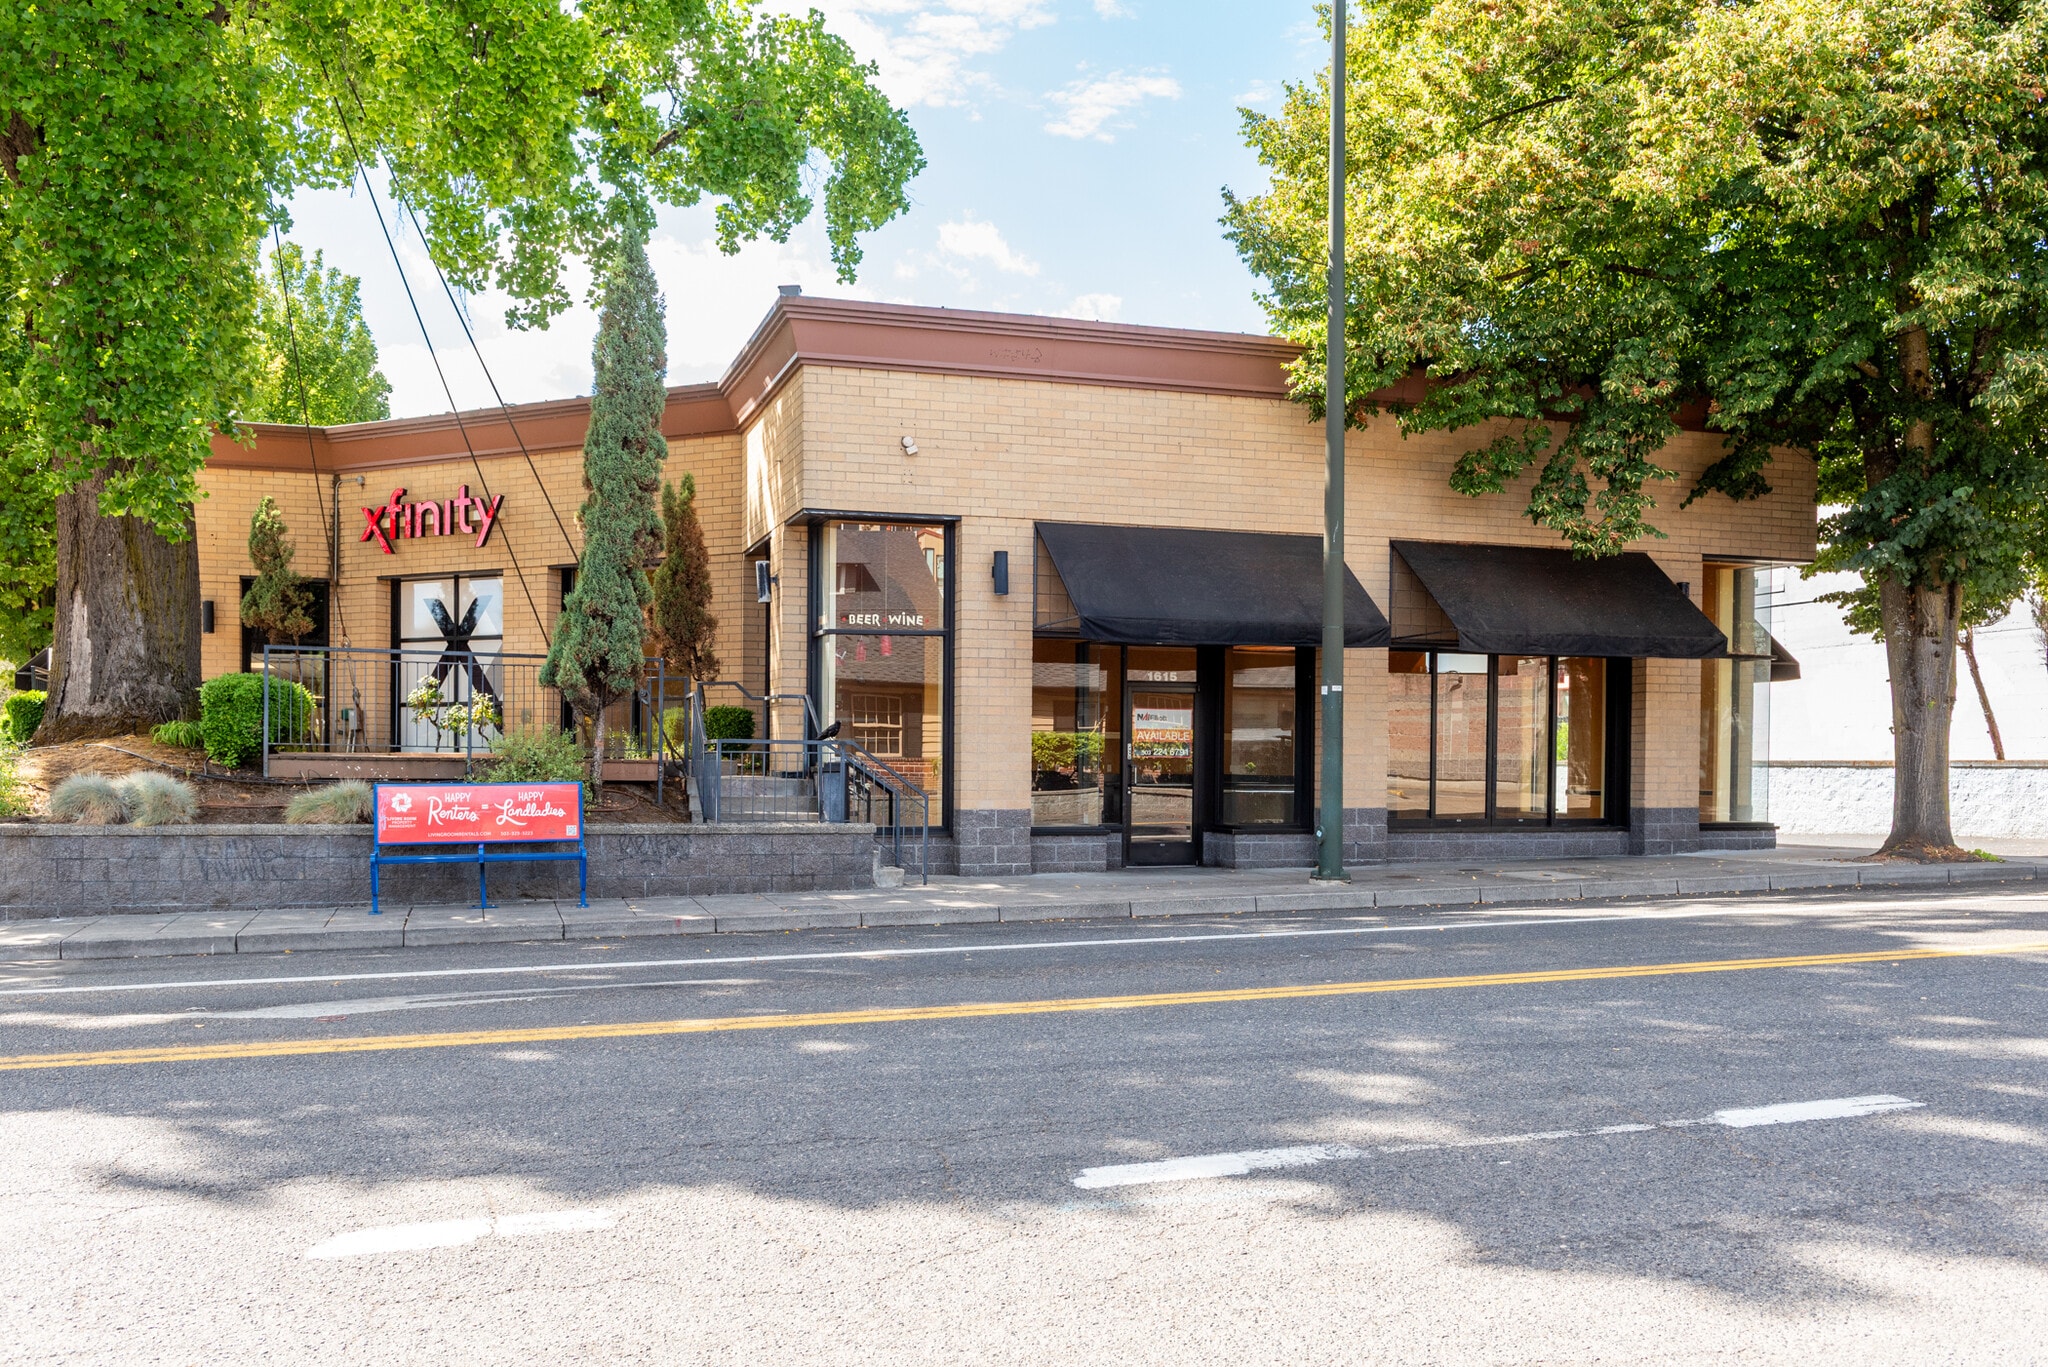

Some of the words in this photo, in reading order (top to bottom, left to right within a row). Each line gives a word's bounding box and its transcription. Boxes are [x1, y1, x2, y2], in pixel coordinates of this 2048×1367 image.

[360, 485, 504, 554] xfinity
[848, 613, 881, 627] BEER
[1147, 671, 1178, 681] 1615
[1137, 731, 1190, 741] AVAILABLE
[1153, 748, 1168, 756] 224
[1169, 748, 1189, 756] 6791
[444, 792, 472, 803] HAPPY
[518, 791, 545, 802] HAPPY
[427, 796, 480, 826] Renters
[494, 798, 566, 826] Landladies
